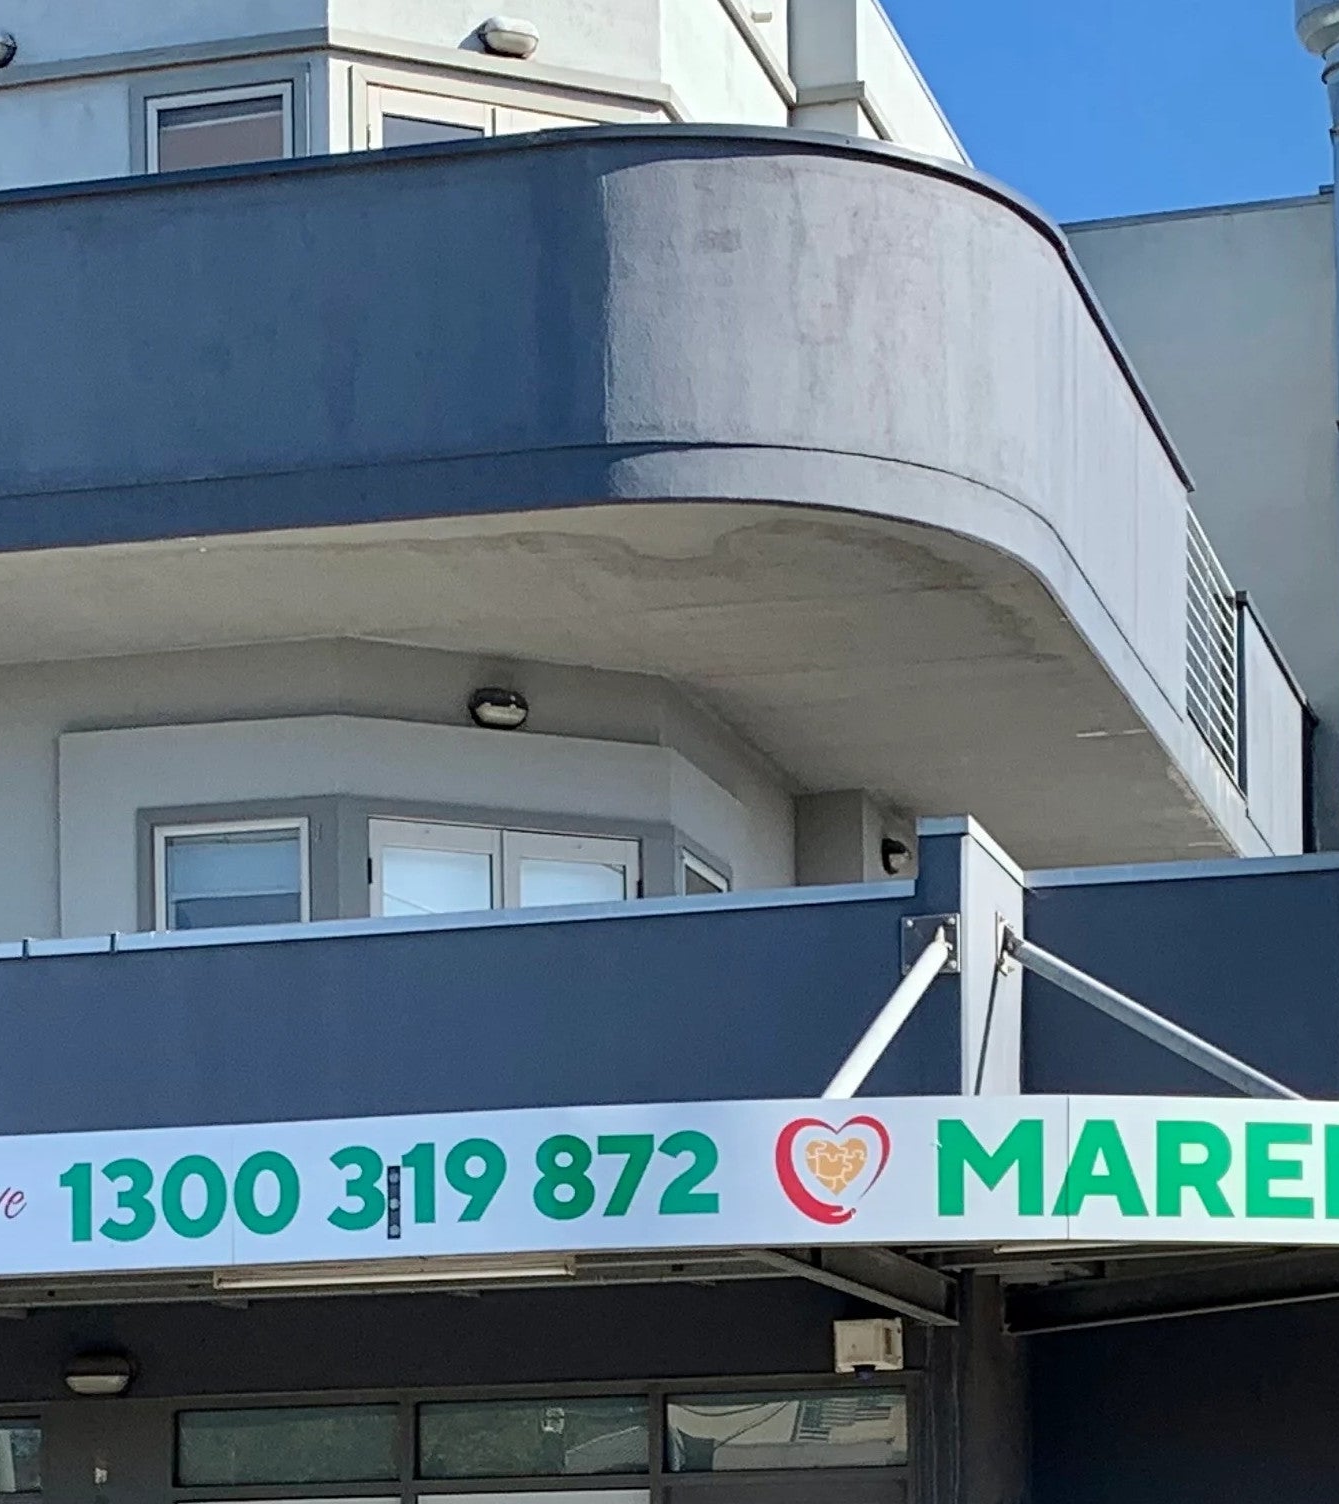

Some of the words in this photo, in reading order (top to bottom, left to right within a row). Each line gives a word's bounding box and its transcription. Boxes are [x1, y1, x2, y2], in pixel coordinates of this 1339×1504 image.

[59, 1151, 300, 1243] 1300
[327, 1138, 507, 1231] 319
[532, 1130, 721, 1220] 872
